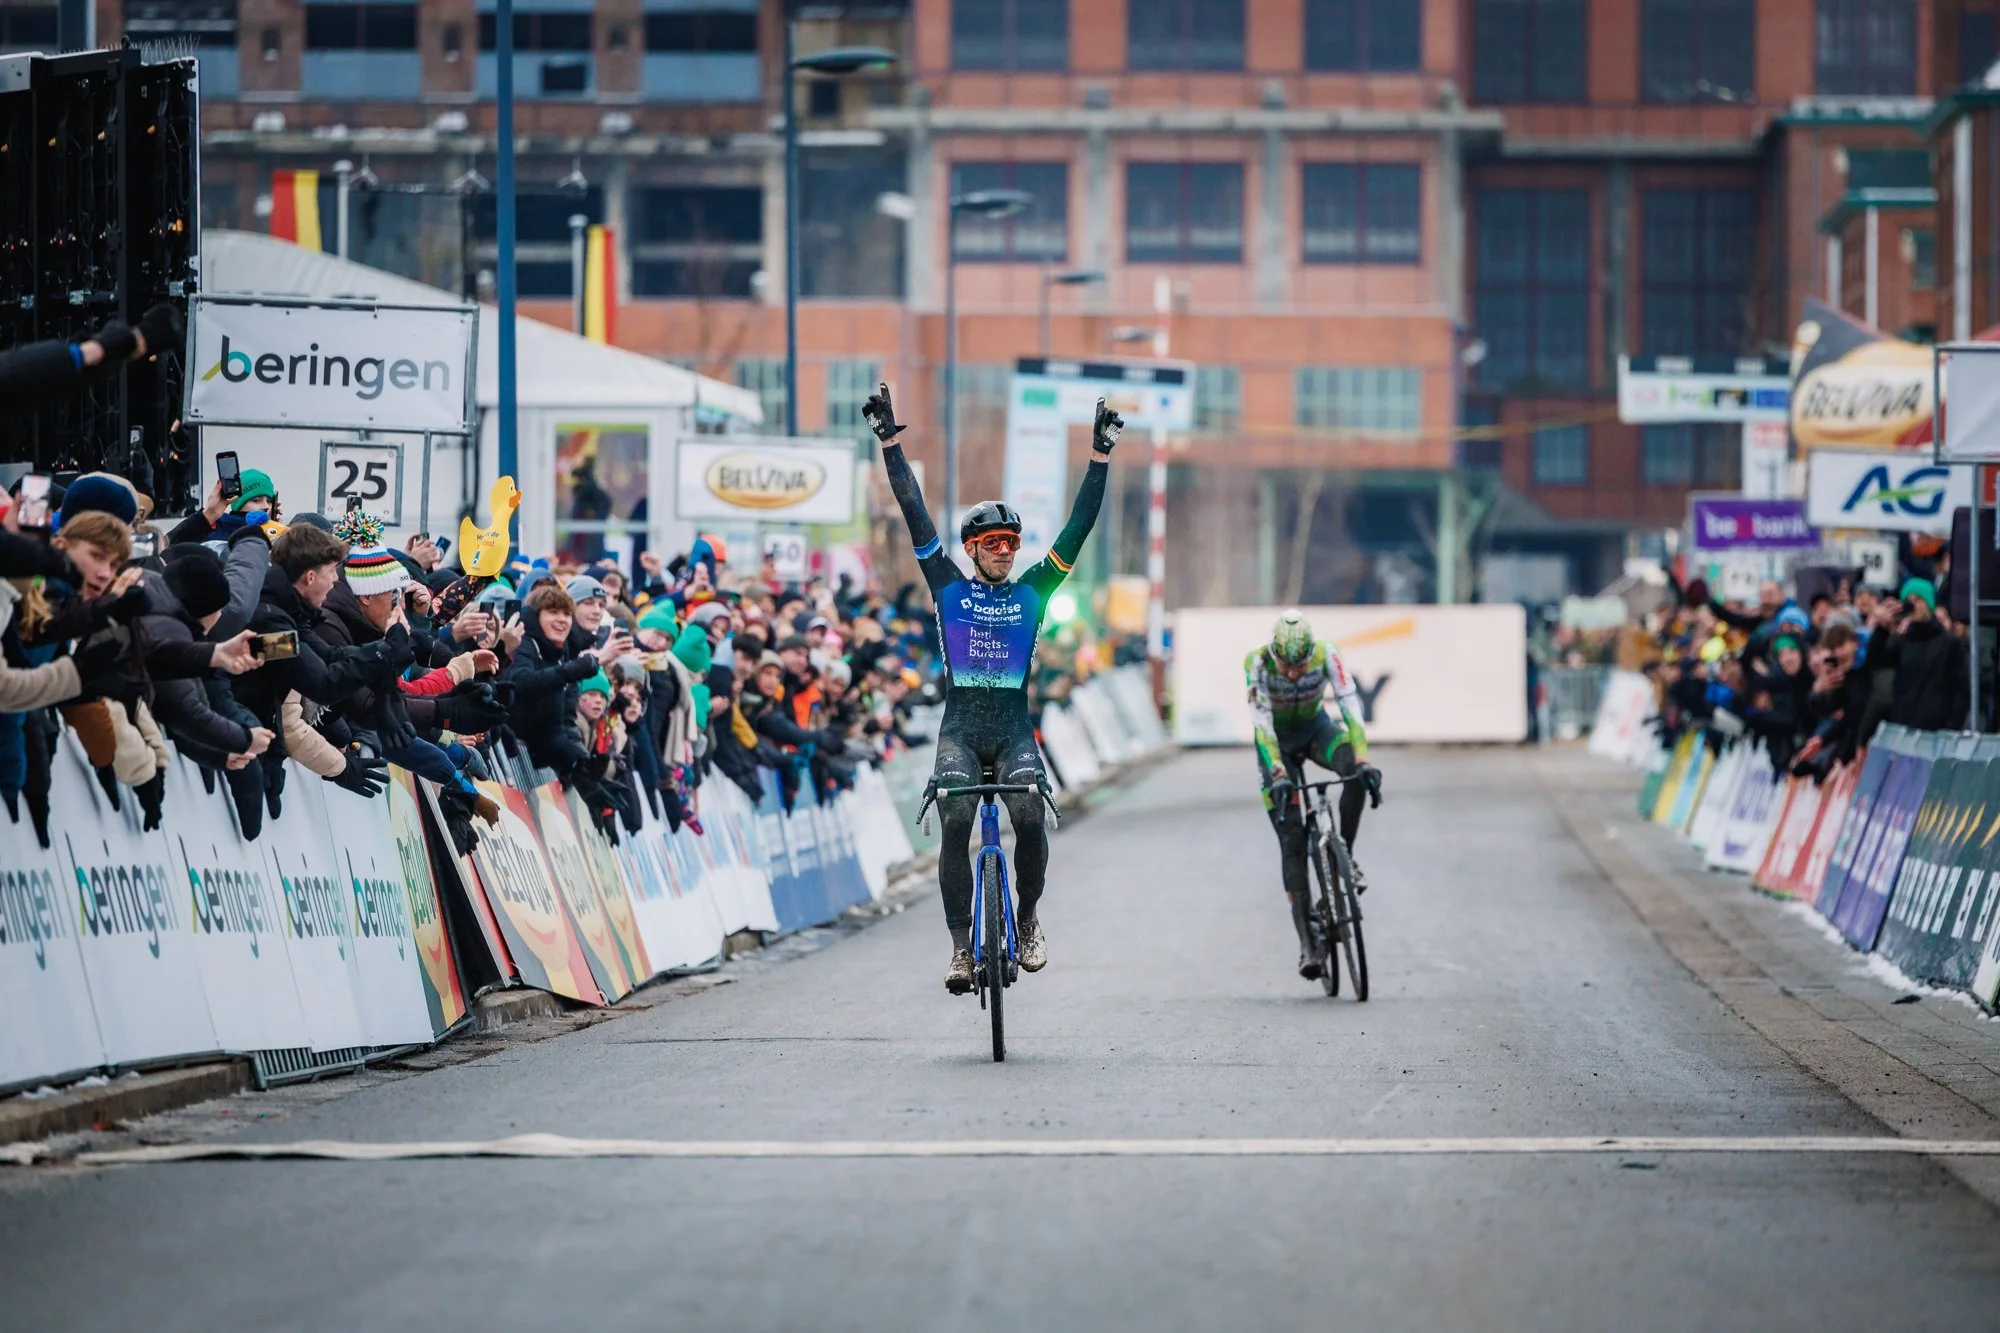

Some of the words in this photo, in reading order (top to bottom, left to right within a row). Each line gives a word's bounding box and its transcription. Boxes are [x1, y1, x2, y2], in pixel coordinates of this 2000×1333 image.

[202, 334, 450, 400] beringen
[330, 459, 388, 500] 25
[719, 466, 808, 491] BELVIVA
[1842, 465, 1950, 517] AG
[970, 626, 990, 639] het
[973, 602, 1021, 615] baloise
[969, 645, 1009, 659] bureau
[65, 830, 179, 959] beringen
[178, 832, 275, 959] beringen
[272, 844, 349, 961] beringen
[345, 845, 412, 961] beringen
